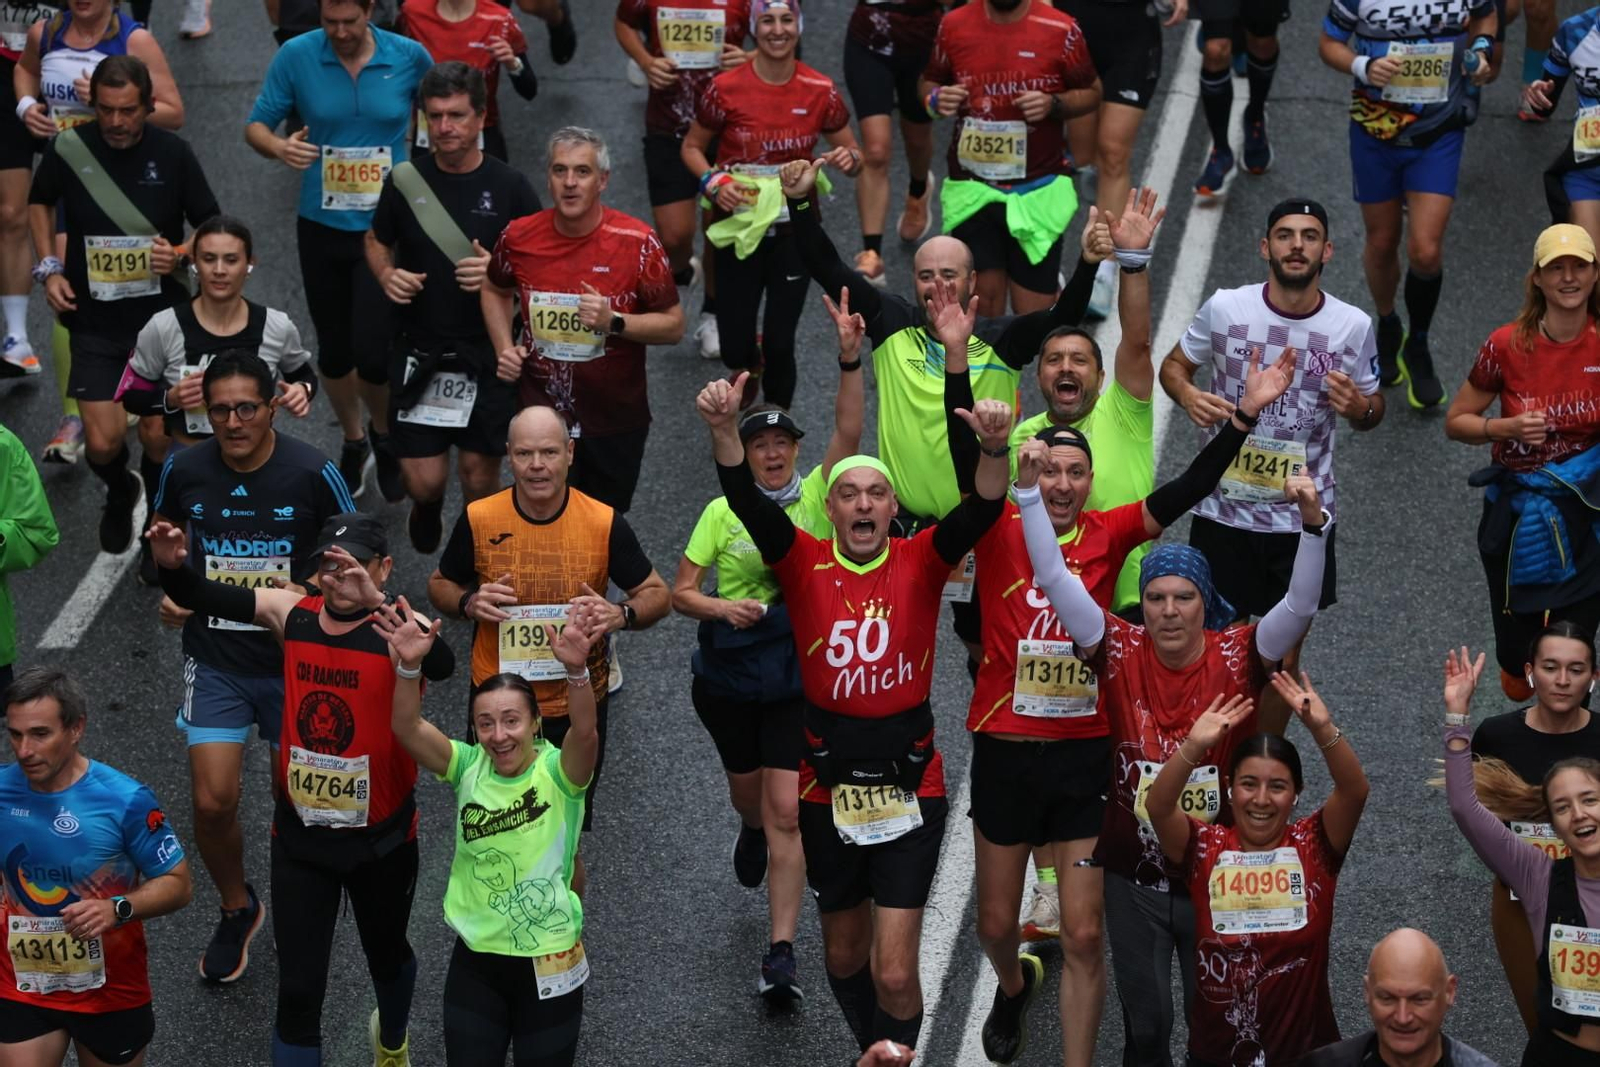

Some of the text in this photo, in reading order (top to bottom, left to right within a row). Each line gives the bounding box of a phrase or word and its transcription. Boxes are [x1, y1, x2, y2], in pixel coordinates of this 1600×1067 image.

[663, 24, 714, 42] 12215
[1400, 59, 1442, 77] 3286
[965, 134, 1015, 155] 13521
[328, 163, 381, 183] 12165
[93, 252, 147, 273] 12191
[201, 537, 292, 557] MADRID
[826, 618, 890, 668] 50
[313, 665, 360, 690] RAMONES
[833, 652, 913, 700] Mich
[1026, 660, 1090, 685] 13115
[293, 768, 355, 798] 14764
[838, 784, 903, 811] 13114
[20, 863, 73, 884] Snell
[1217, 869, 1290, 897] 14096
[16, 938, 87, 962] 13113
